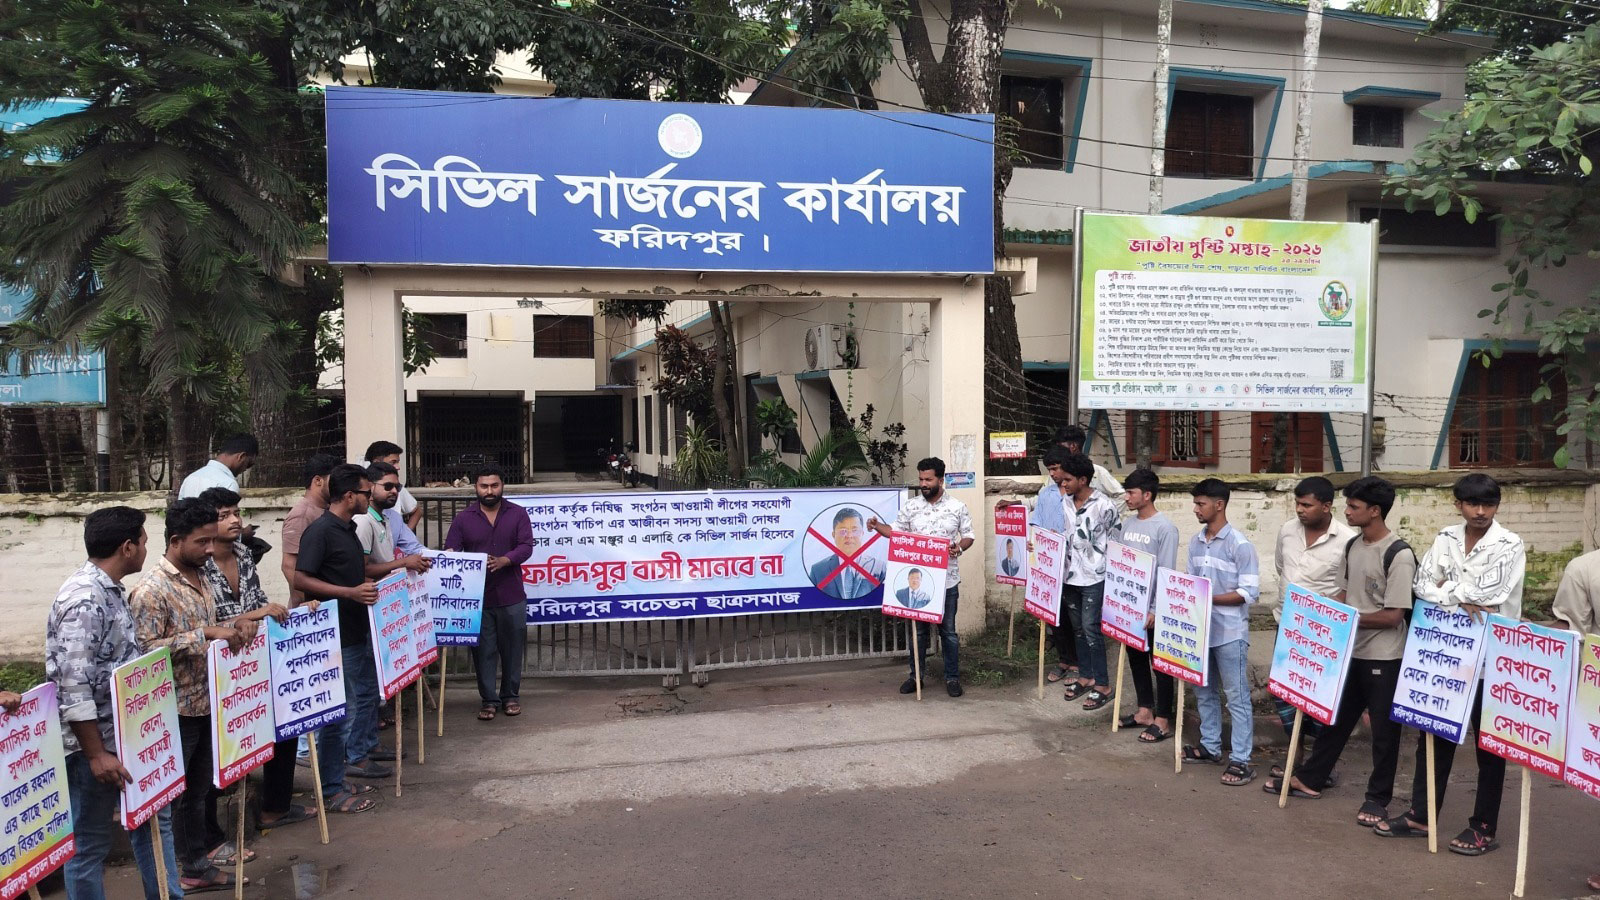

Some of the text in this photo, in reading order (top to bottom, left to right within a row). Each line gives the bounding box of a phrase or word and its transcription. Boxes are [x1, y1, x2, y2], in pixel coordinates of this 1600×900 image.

[364, 153, 967, 225] সিভিল সার্জনের কার্যালয়
[594, 224, 745, 254] ফরিদপুর
[1128, 236, 1184, 253] জাতীয়
[1189, 237, 1224, 259] পুষ্টি
[1283, 243, 1321, 255] ২০২৬
[524, 496, 791, 518] রকার কর্তৃক নিষিদ্ধ সংগঠন আওয়ামী লীগের সহযোগী
[531, 513, 780, 532] সংগঠন স্বাচিপ এর আজীবন সদস্য আওয়ামী দোষর
[554, 536, 573, 547] এস
[577, 535, 595, 546] এম
[627, 534, 637, 544] এ
[641, 531, 673, 543] এলাহি
[677, 533, 691, 543] কে
[694, 529, 726, 542] সিভিল
[730, 527, 757, 541] সার্জন
[761, 527, 794, 540] হিসেবে
[520, 551, 784, 592] ফরিদপুর বাসী মানবে না
[935, 555, 942, 564] না
[440, 574, 465, 593] মাটি,
[526, 591, 801, 618] ফরিদপুর সচেতন ছাত্রসমাজ
[1290, 591, 1349, 623] ফ্যাসিবাদকে
[1423, 606, 1473, 629] ফরিদপুরে
[433, 617, 471, 630] ন্য নয়!
[1294, 613, 1332, 642] না বলুন,
[275, 627, 335, 652] ফ্যাসিবাদের
[1284, 627, 1338, 660] ফরিদপুরকে
[1414, 626, 1475, 650] ফ্যাসিবাদের
[1492, 623, 1567, 659] ফ্যাসিবাদ
[124, 657, 168, 689] স্বাচিপ নেতা
[230, 660, 258, 681] মাটিতে
[1289, 648, 1324, 676] নিরাপদ
[1418, 648, 1461, 670] পুনর্বাসন
[278, 666, 339, 697] মেনে নেওয়া
[1288, 669, 1317, 693] রাখুন!
[1404, 667, 1466, 694] মেনে নেওয়া
[1496, 655, 1557, 693] যেখানে,
[125, 678, 173, 719] সিভিল সার্জন
[222, 680, 269, 710] ফ্যাসিবাদের
[289, 690, 331, 714] হবে না!
[1409, 688, 1450, 711] হবে না!
[1490, 682, 1560, 722] প্রতিরোধ
[34, 720, 47, 736] এর
[141, 712, 165, 738] কেনো,
[226, 700, 267, 734] প্রত্যাবর্তন
[240, 733, 257, 752] নয়!
[1494, 715, 1552, 751] সেখানে
[8, 749, 43, 780] সুপারিশ,
[138, 755, 177, 792] জবাব চাই
[1, 767, 56, 808] তারেক রহমান
[5, 791, 59, 835] এর কাছে যাবে
[0, 845, 16, 866] তার
[46, 810, 70, 836] নালিশ
